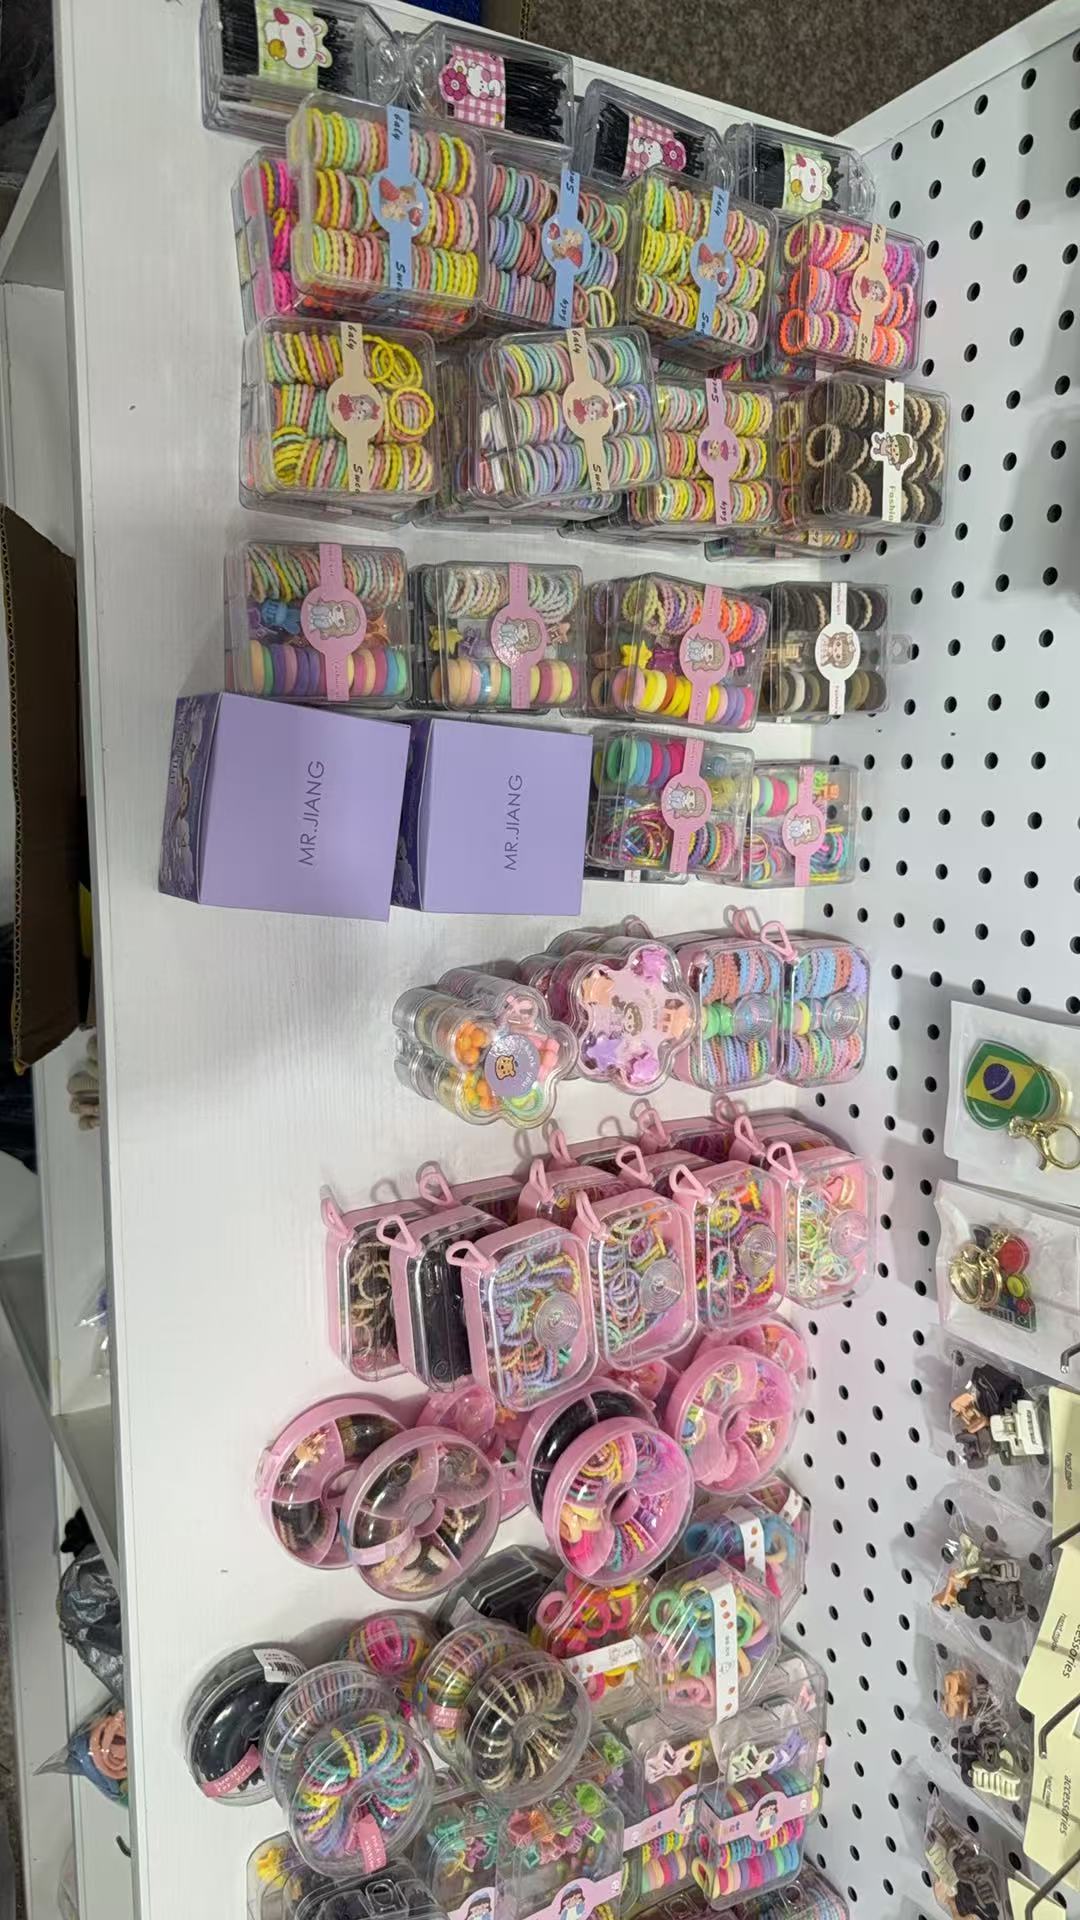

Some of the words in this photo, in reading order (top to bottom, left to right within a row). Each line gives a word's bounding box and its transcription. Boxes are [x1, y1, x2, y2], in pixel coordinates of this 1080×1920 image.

[299, 761, 324, 865] MR.JIANG
[504, 775, 522, 870] MR.JIANG
[1062, 1624, 1080, 1679] essories
[1059, 1775, 1073, 1836] accessories
